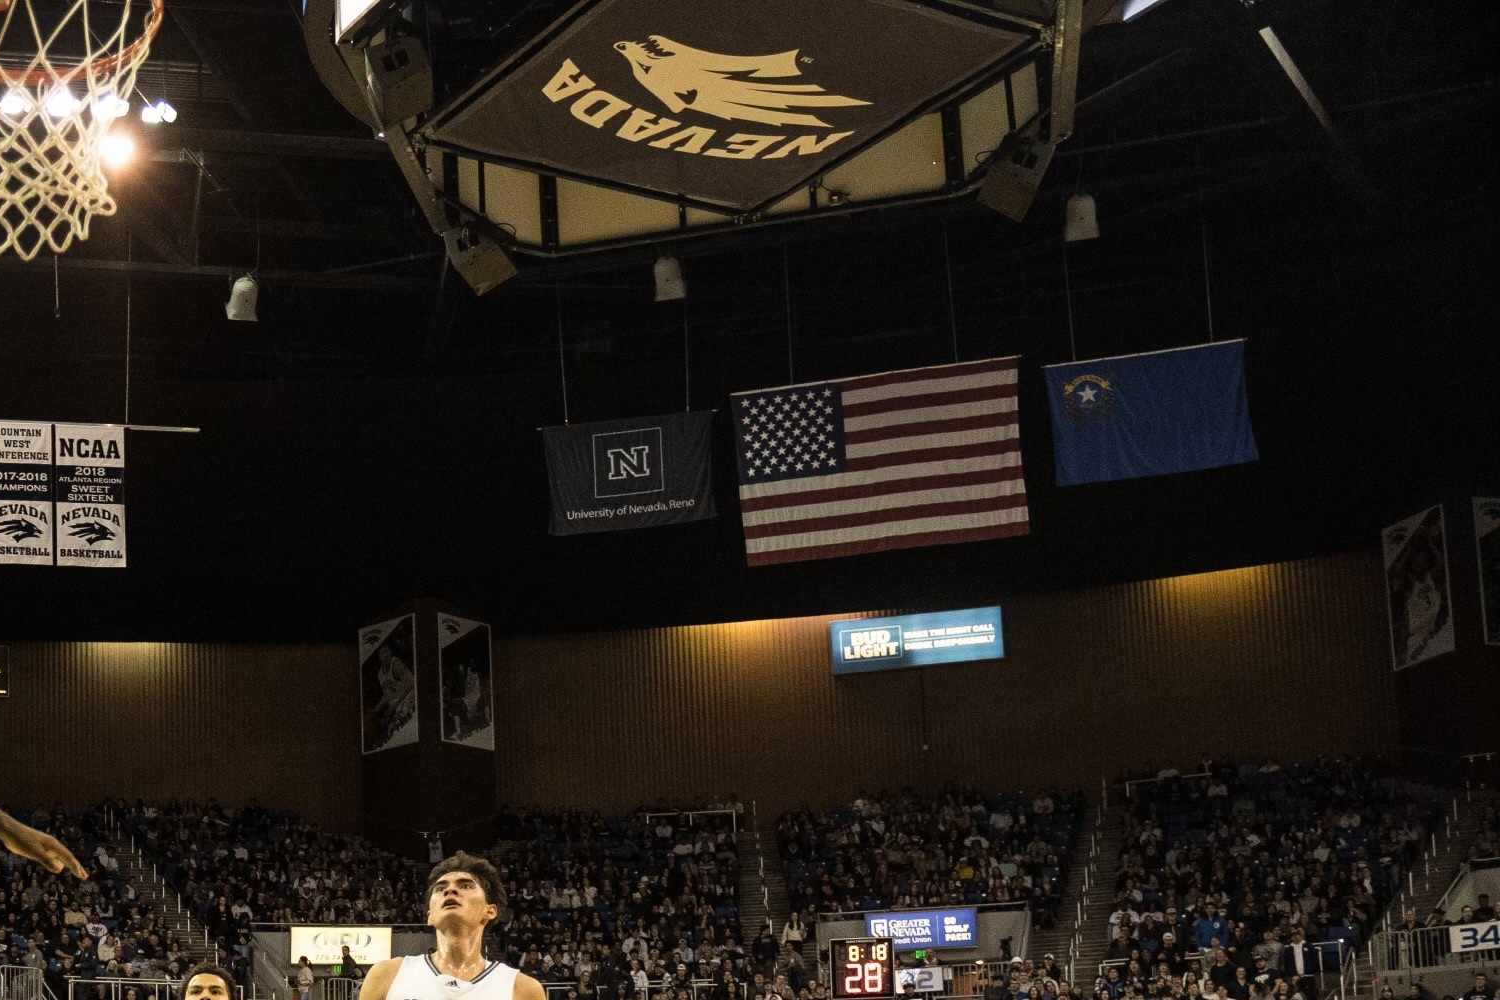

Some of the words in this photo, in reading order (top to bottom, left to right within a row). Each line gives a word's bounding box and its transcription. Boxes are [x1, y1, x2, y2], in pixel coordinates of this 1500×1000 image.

[541, 58, 855, 159] NEVADA
[4, 440, 31, 449] WEST
[59, 438, 120, 459] NCAA
[607, 446, 649, 480] N
[75, 467, 105, 476] 2018
[71, 485, 110, 493] SWEET
[68, 493, 113, 502] SIXTEEN
[61, 507, 121, 527] NEVADA
[567, 507, 614, 520] University
[617, 506, 626, 515] of
[629, 502, 667, 514] Nevada,
[669, 499, 694, 509] Reno
[60, 549, 123, 559] BASKETBALL
[851, 630, 890, 645] BUD
[844, 642, 898, 660] LIGHT
[889, 919, 930, 927] GREATER
[945, 924, 969, 932] WOLF
[889, 927, 931, 936] NEVADA
[1460, 925, 1500, 948] 34
[849, 944, 887, 961] 8:18
[845, 963, 882, 993] 28
